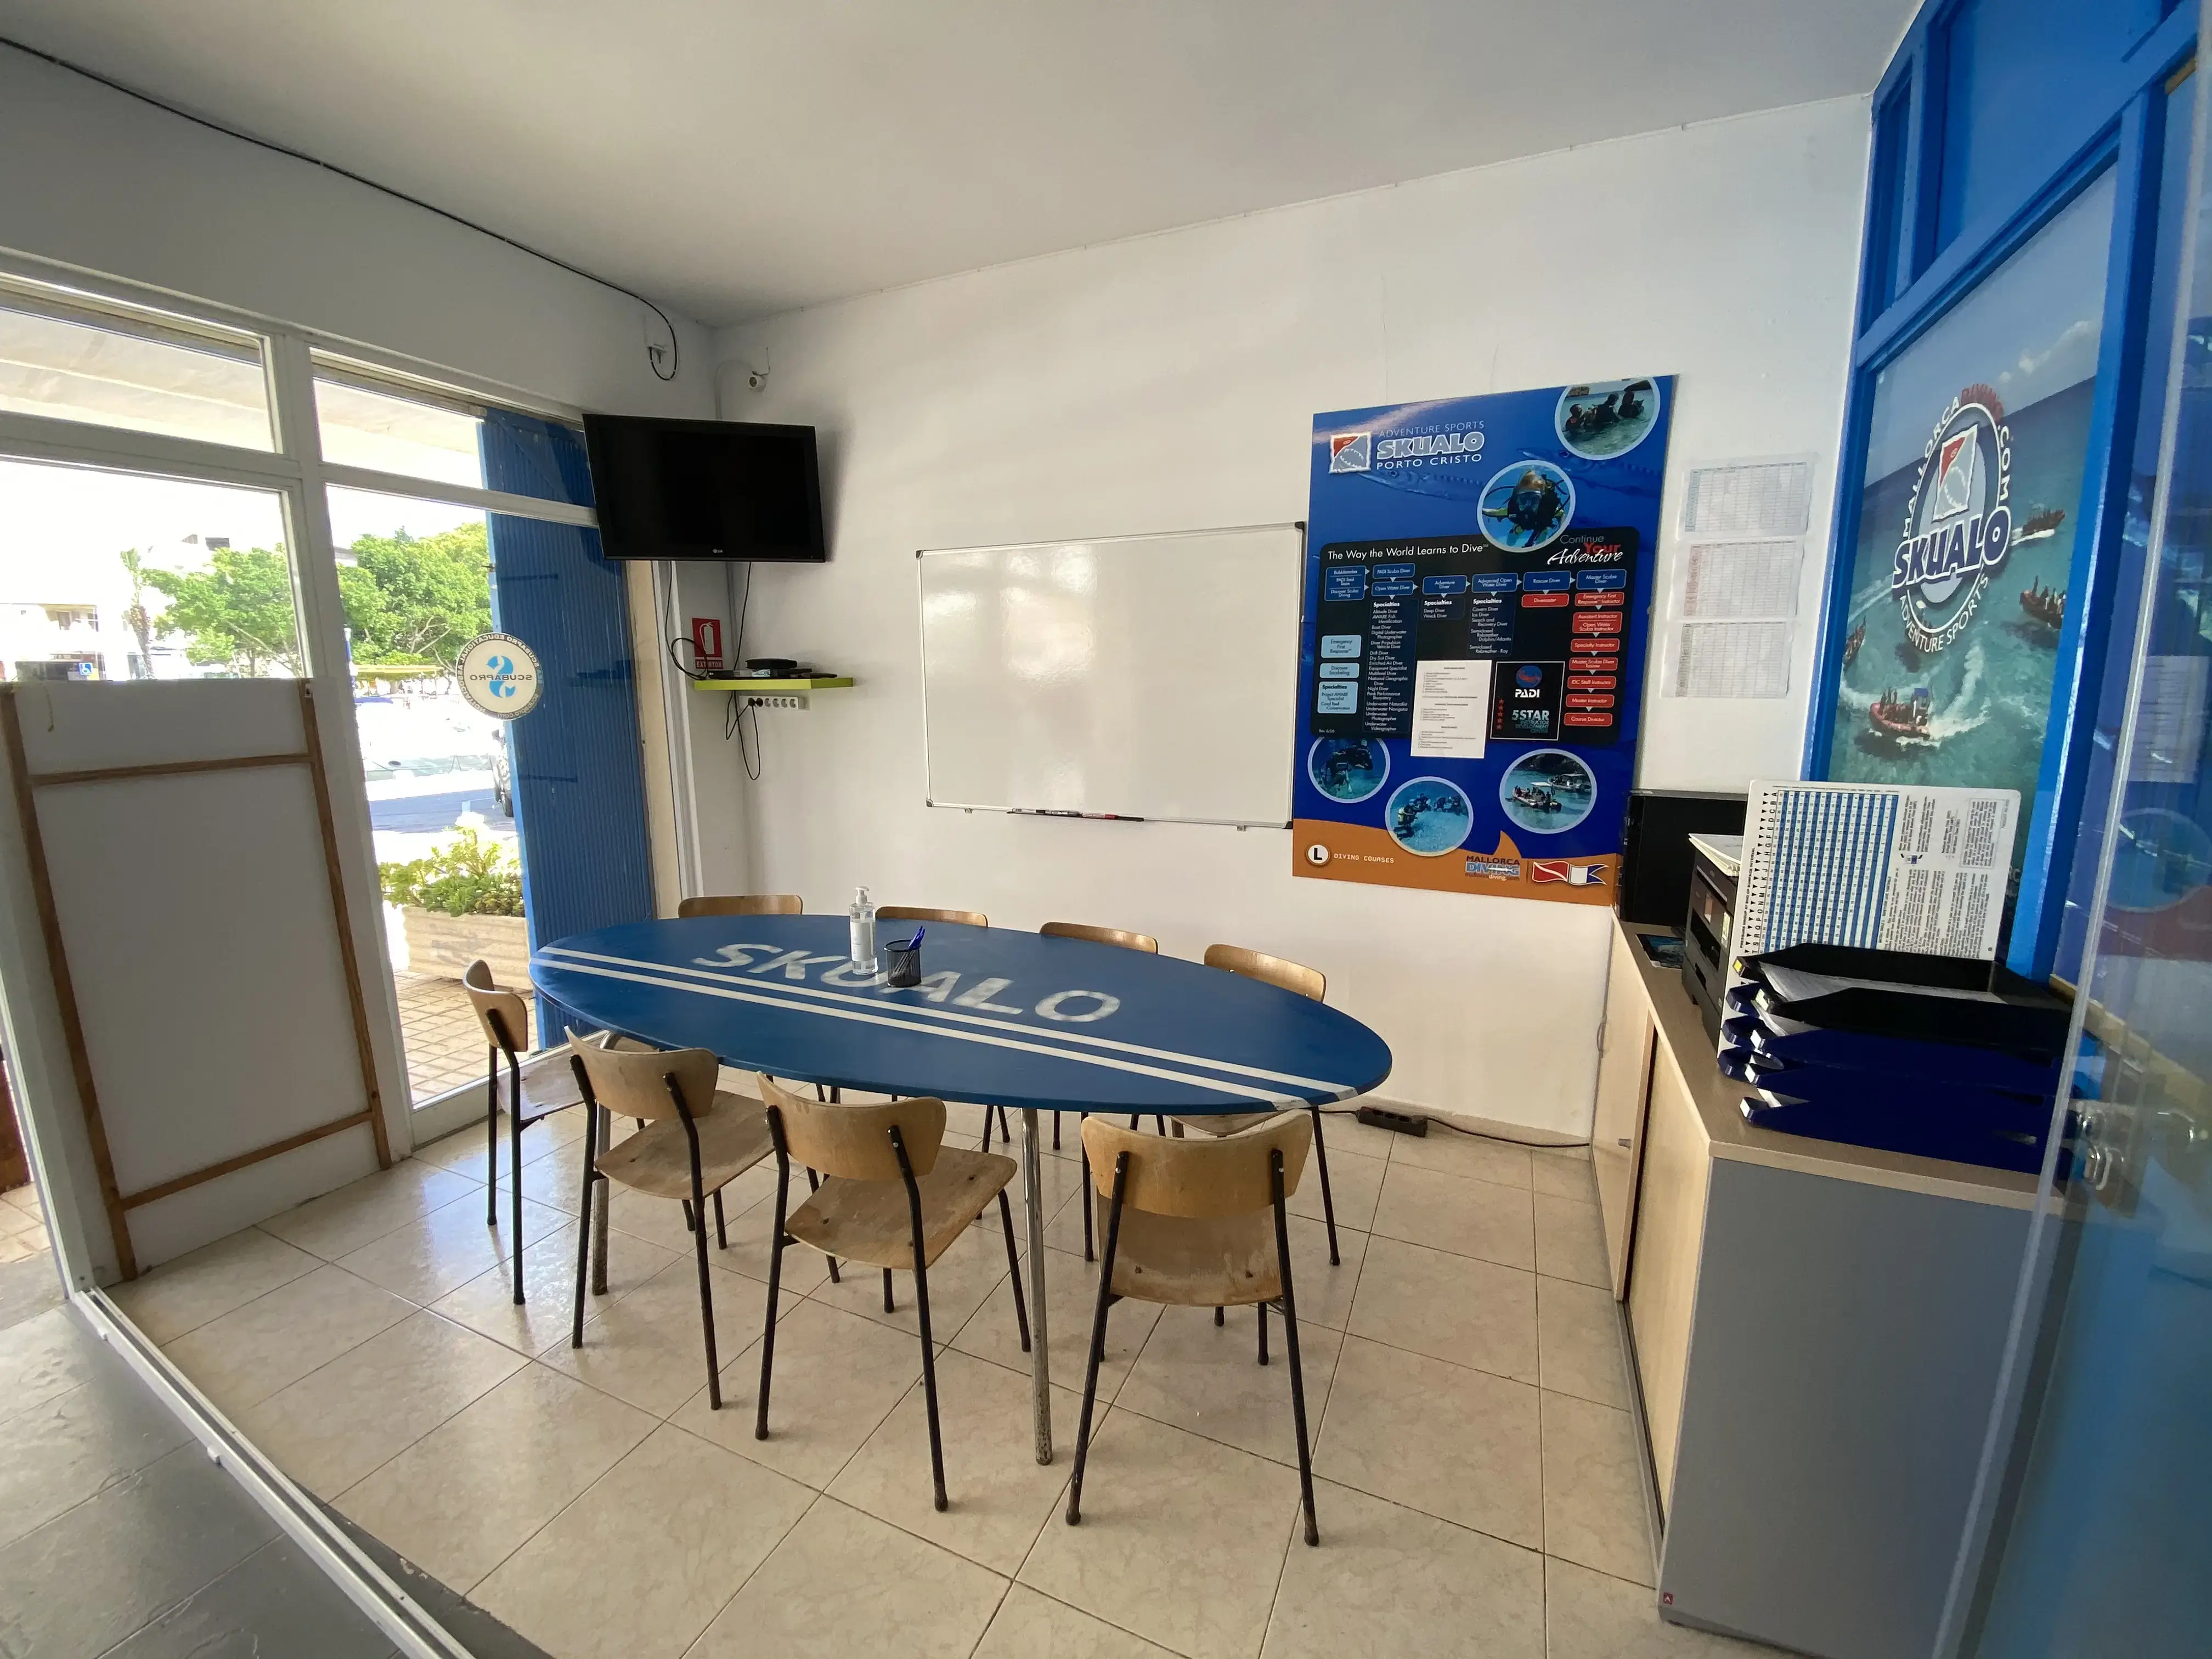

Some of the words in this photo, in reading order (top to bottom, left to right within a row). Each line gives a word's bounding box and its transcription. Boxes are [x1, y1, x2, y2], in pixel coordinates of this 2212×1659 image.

[1379, 425, 1440, 438] ADVENTURE
[1444, 420, 1485, 432] SPORTS
[1376, 431, 1485, 460] SKUALO
[1376, 459, 1423, 470] PORTO
[1430, 454, 1482, 465] CRISTO
[1560, 535, 1604, 544] Continue
[1892, 506, 2011, 588] SKUALO
[1328, 551, 1343, 560] The
[1346, 549, 1367, 561] Way
[1369, 548, 1384, 558] the
[1386, 546, 1414, 557] World
[1417, 546, 1447, 555] Learns
[1584, 541, 1622, 555] Your
[1547, 549, 1623, 565] Adventure
[1899, 595, 1944, 653] ADVENTURE
[1946, 573, 1989, 645] SPORTS
[1515, 689, 1539, 698] PADI
[1314, 848, 1322, 860] L
[1466, 855, 1520, 866] MALLORCA
[1465, 861, 1520, 876] DIVING
